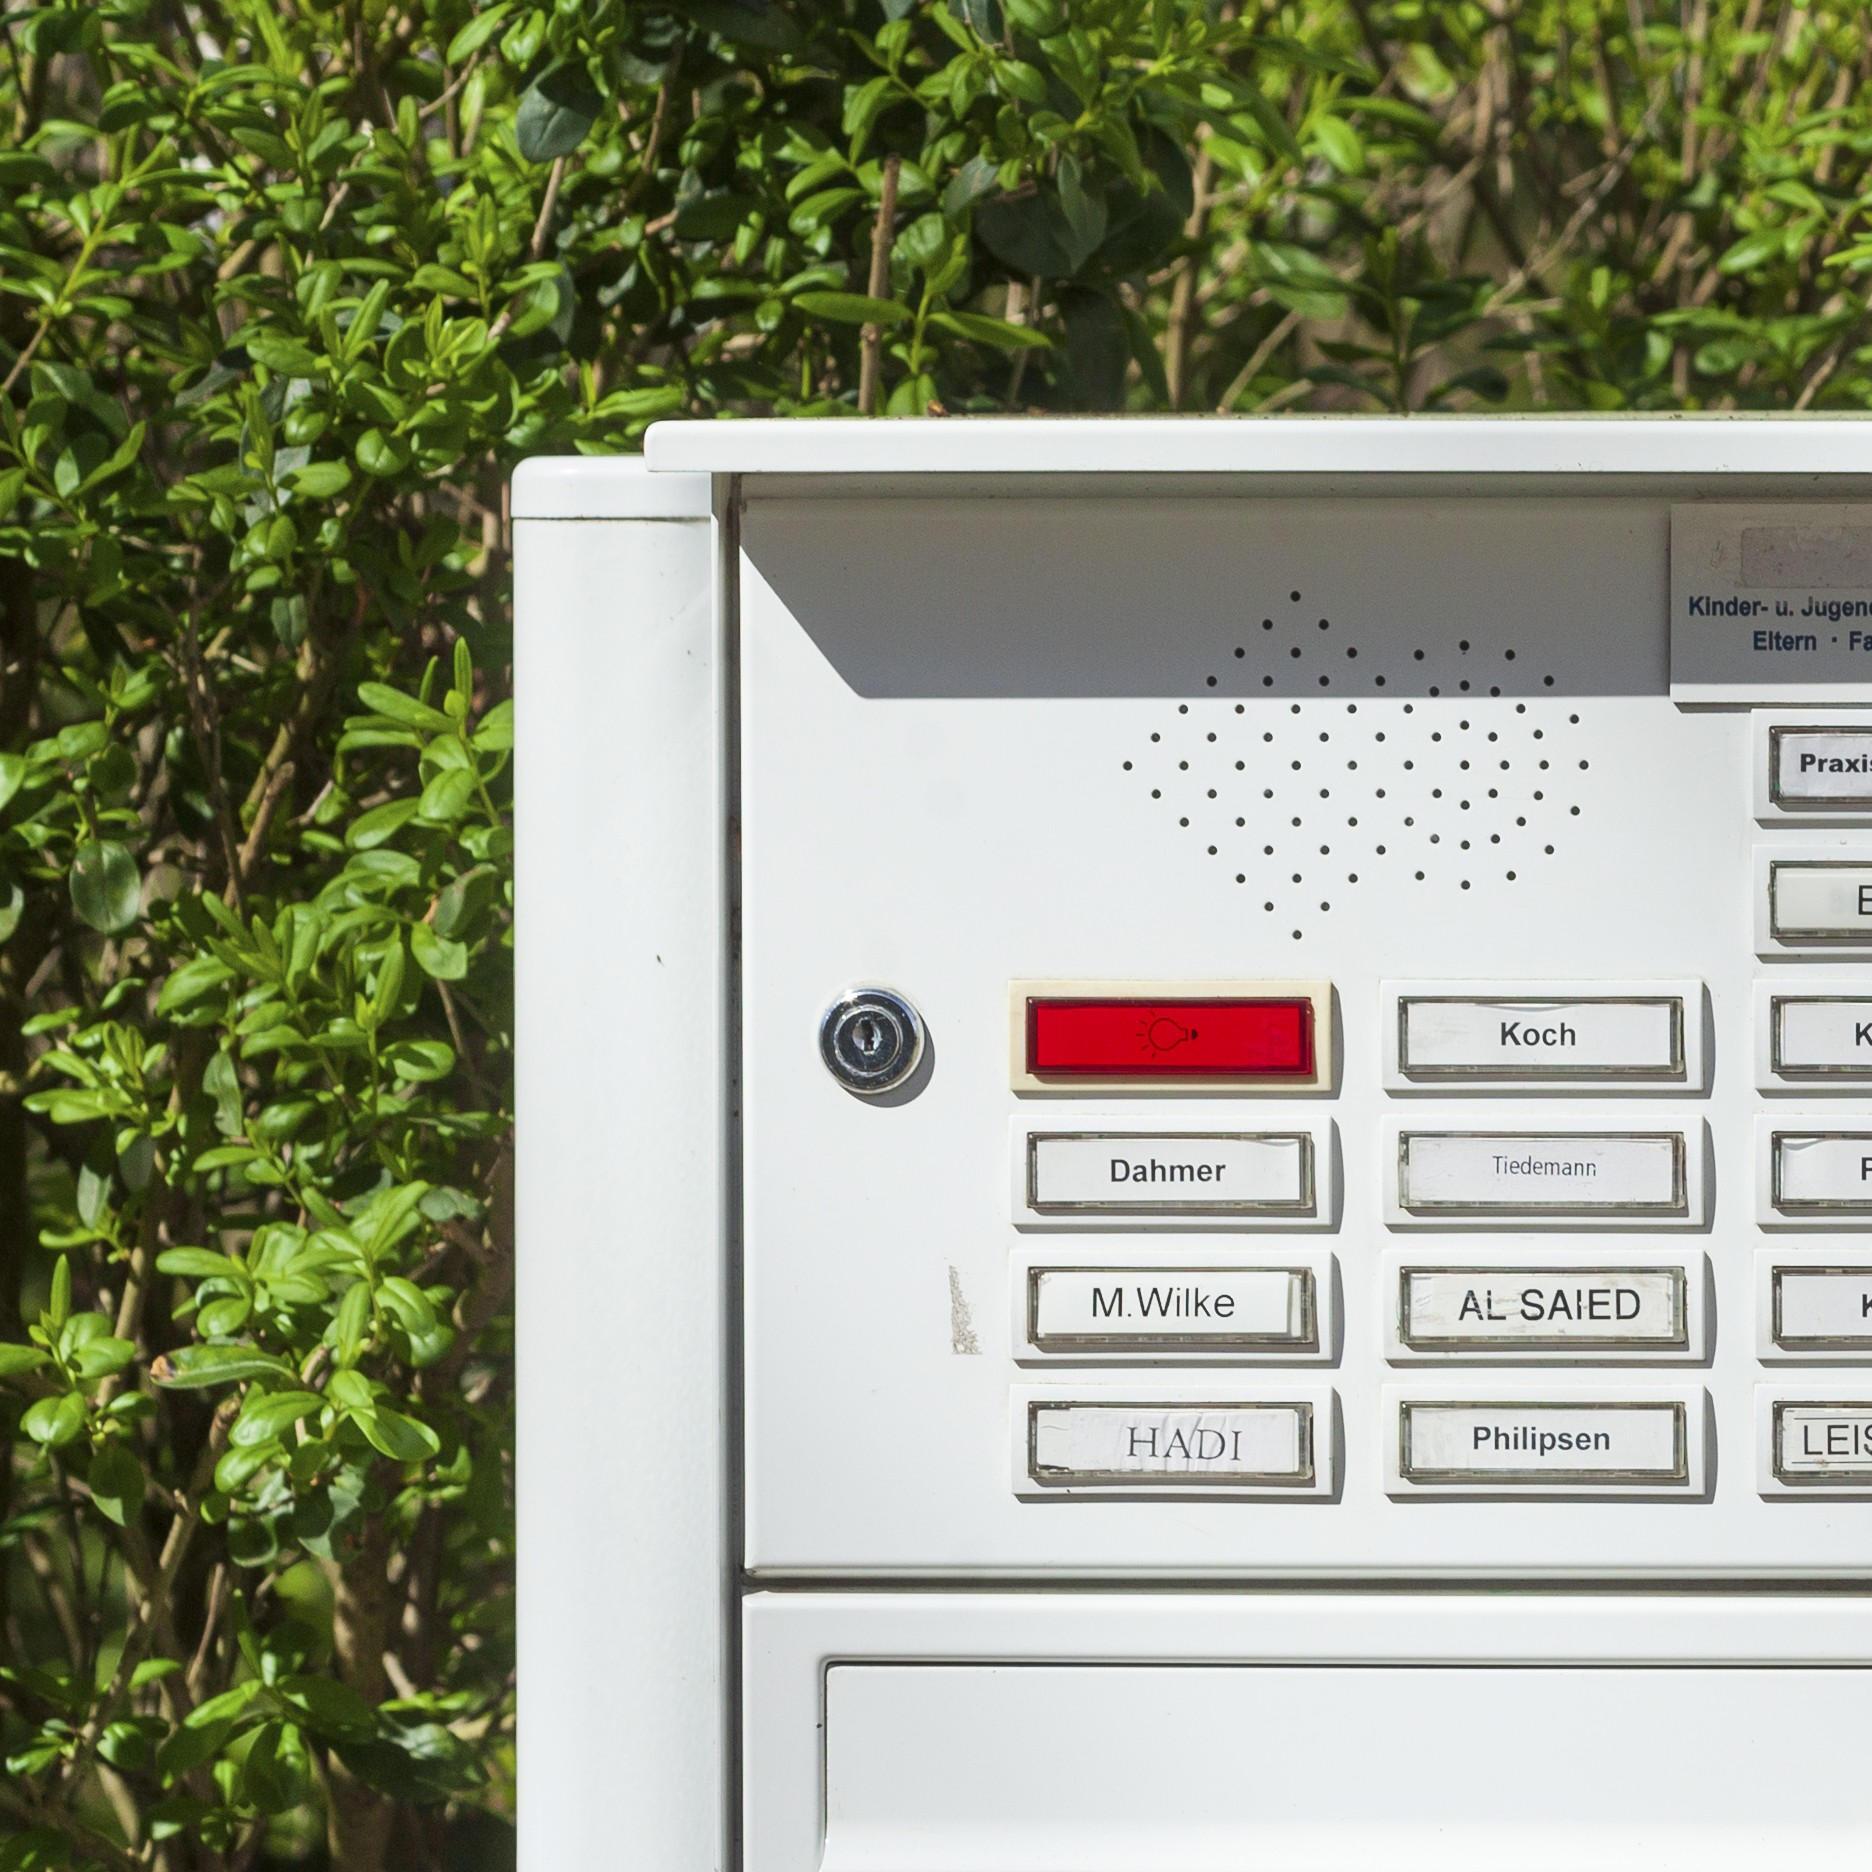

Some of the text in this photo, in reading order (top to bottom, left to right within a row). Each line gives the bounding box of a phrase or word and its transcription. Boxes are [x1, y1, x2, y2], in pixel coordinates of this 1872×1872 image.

[1689, 596, 1769, 616] Kinder-
[1775, 600, 1795, 617] u.
[1754, 631, 1817, 651] Eltern
[1501, 1022, 1576, 1046] Koch
[1111, 1158, 1226, 1183] Dahmer
[1493, 1156, 1596, 1177] Tiedemann
[1092, 1288, 1235, 1318] M.Wilke
[1459, 1289, 1640, 1320] AL SAIED
[1126, 1427, 1240, 1460] HADI
[1473, 1426, 1610, 1457] Philipsen
